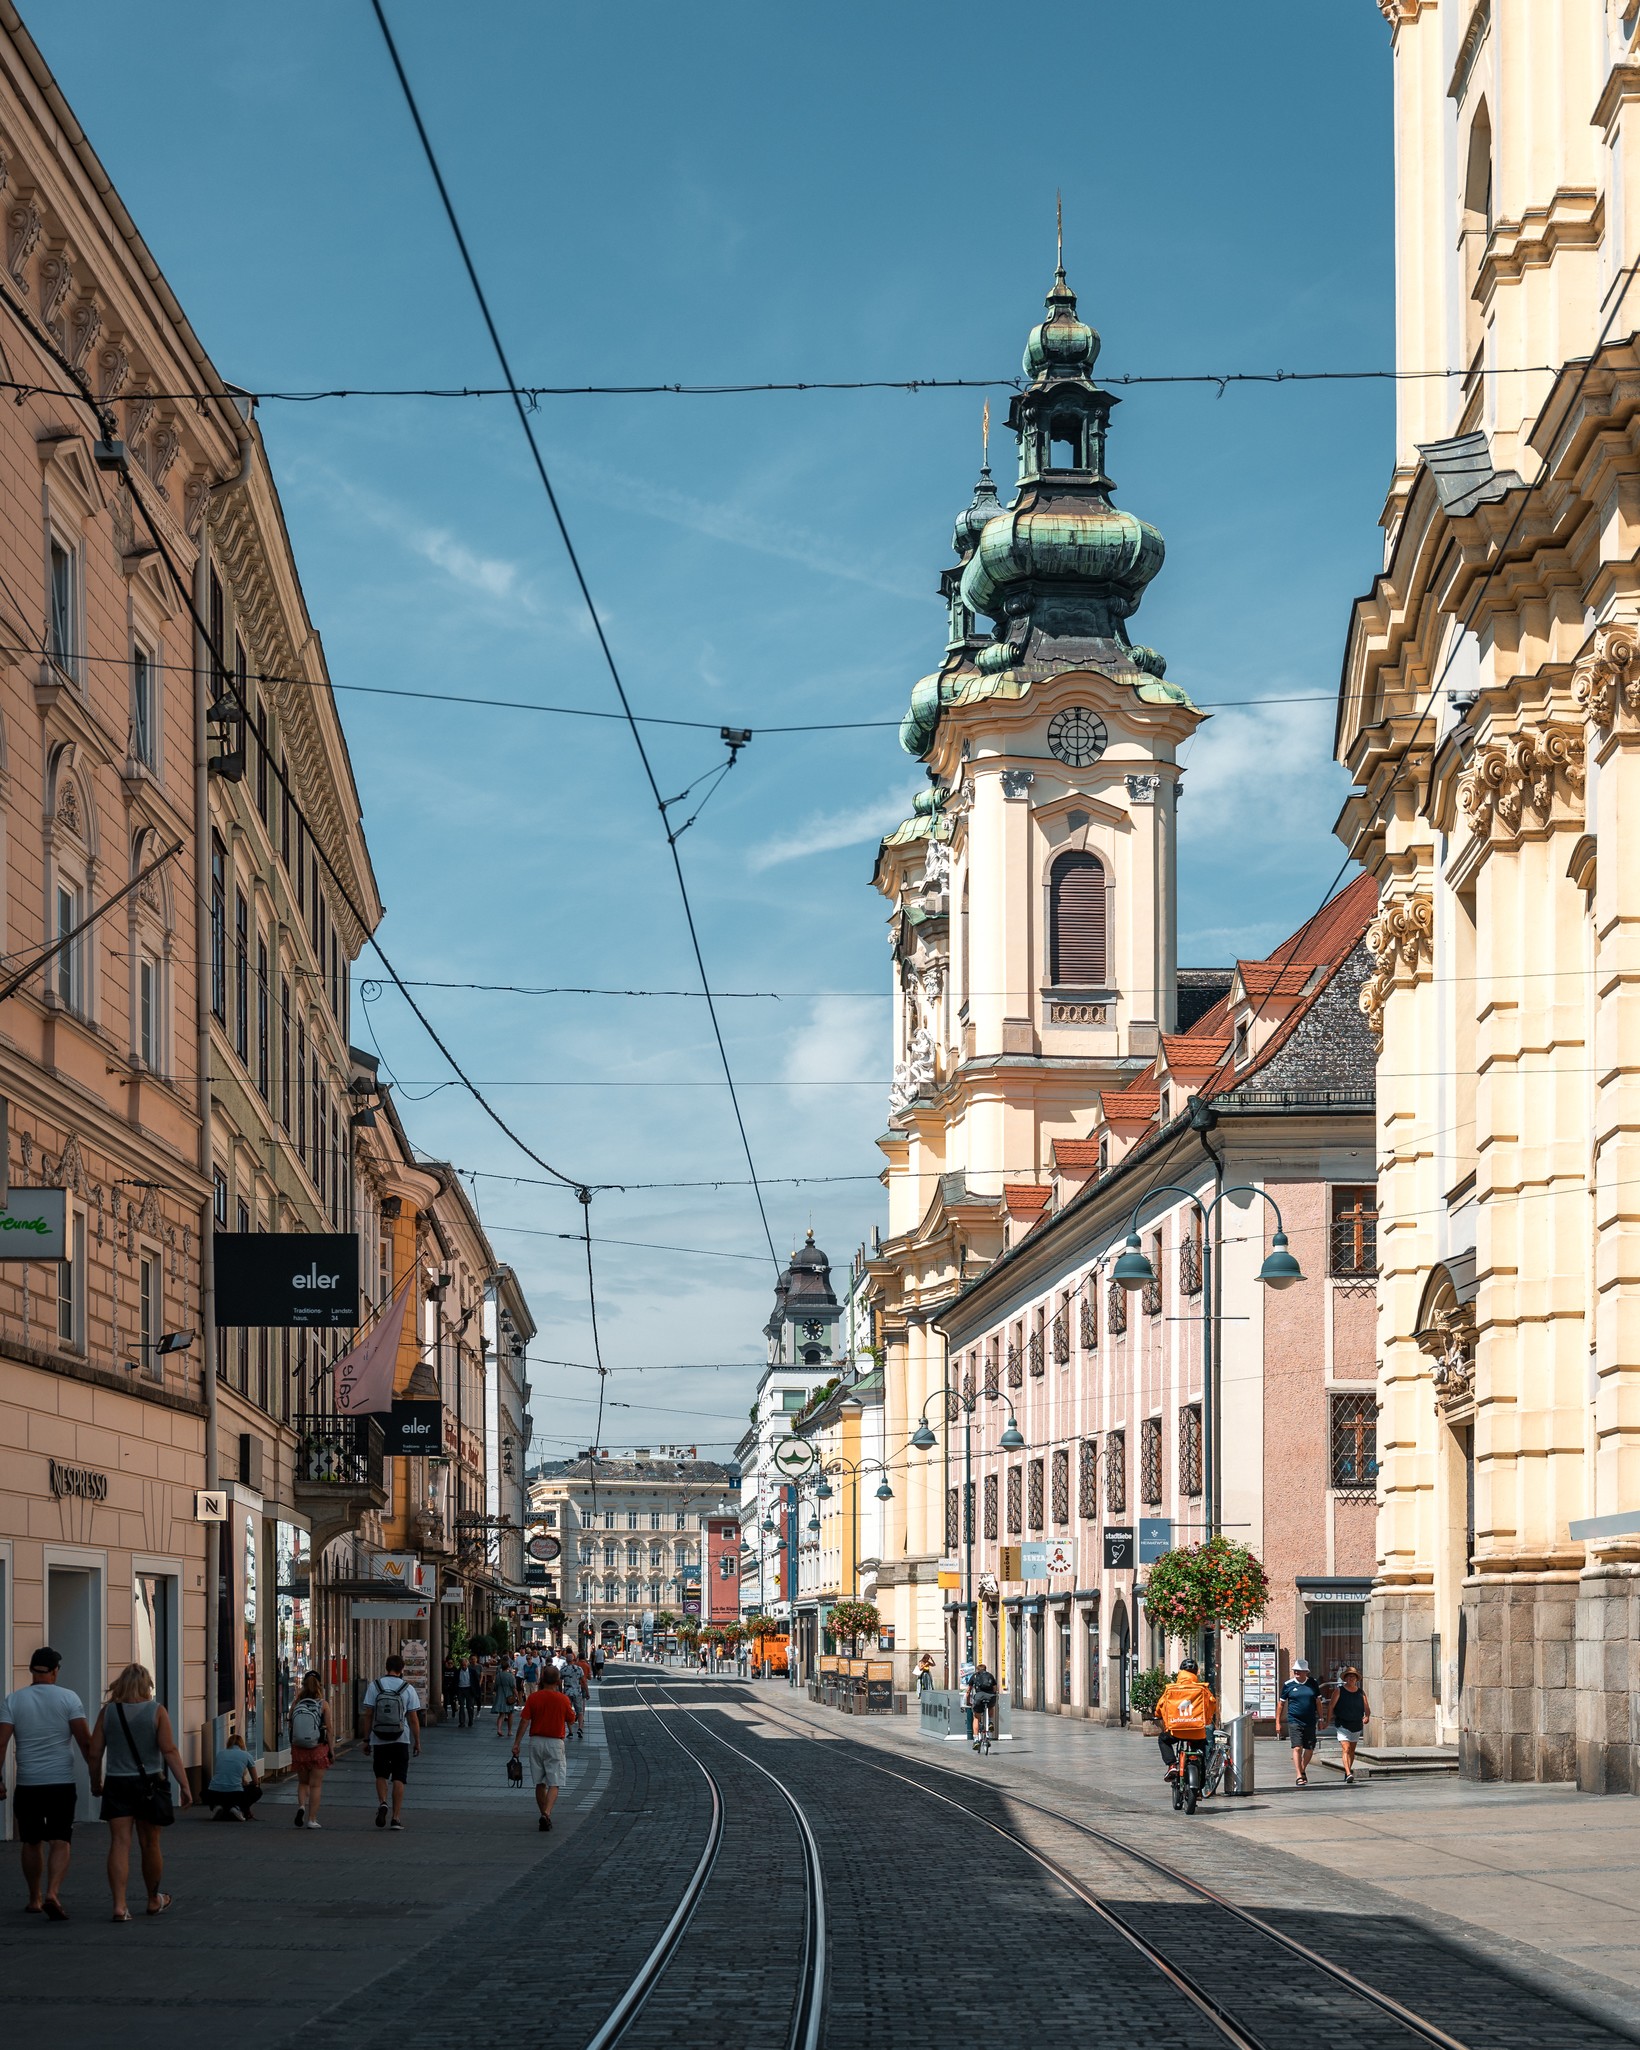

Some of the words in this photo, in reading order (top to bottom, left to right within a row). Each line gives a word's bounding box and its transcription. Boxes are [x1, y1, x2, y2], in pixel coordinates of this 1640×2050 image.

[49, 1458, 108, 1500] NESPRESSO
[1105, 1532, 1133, 1540] stadtliebe
[1022, 1554, 1046, 1562] SENZA
